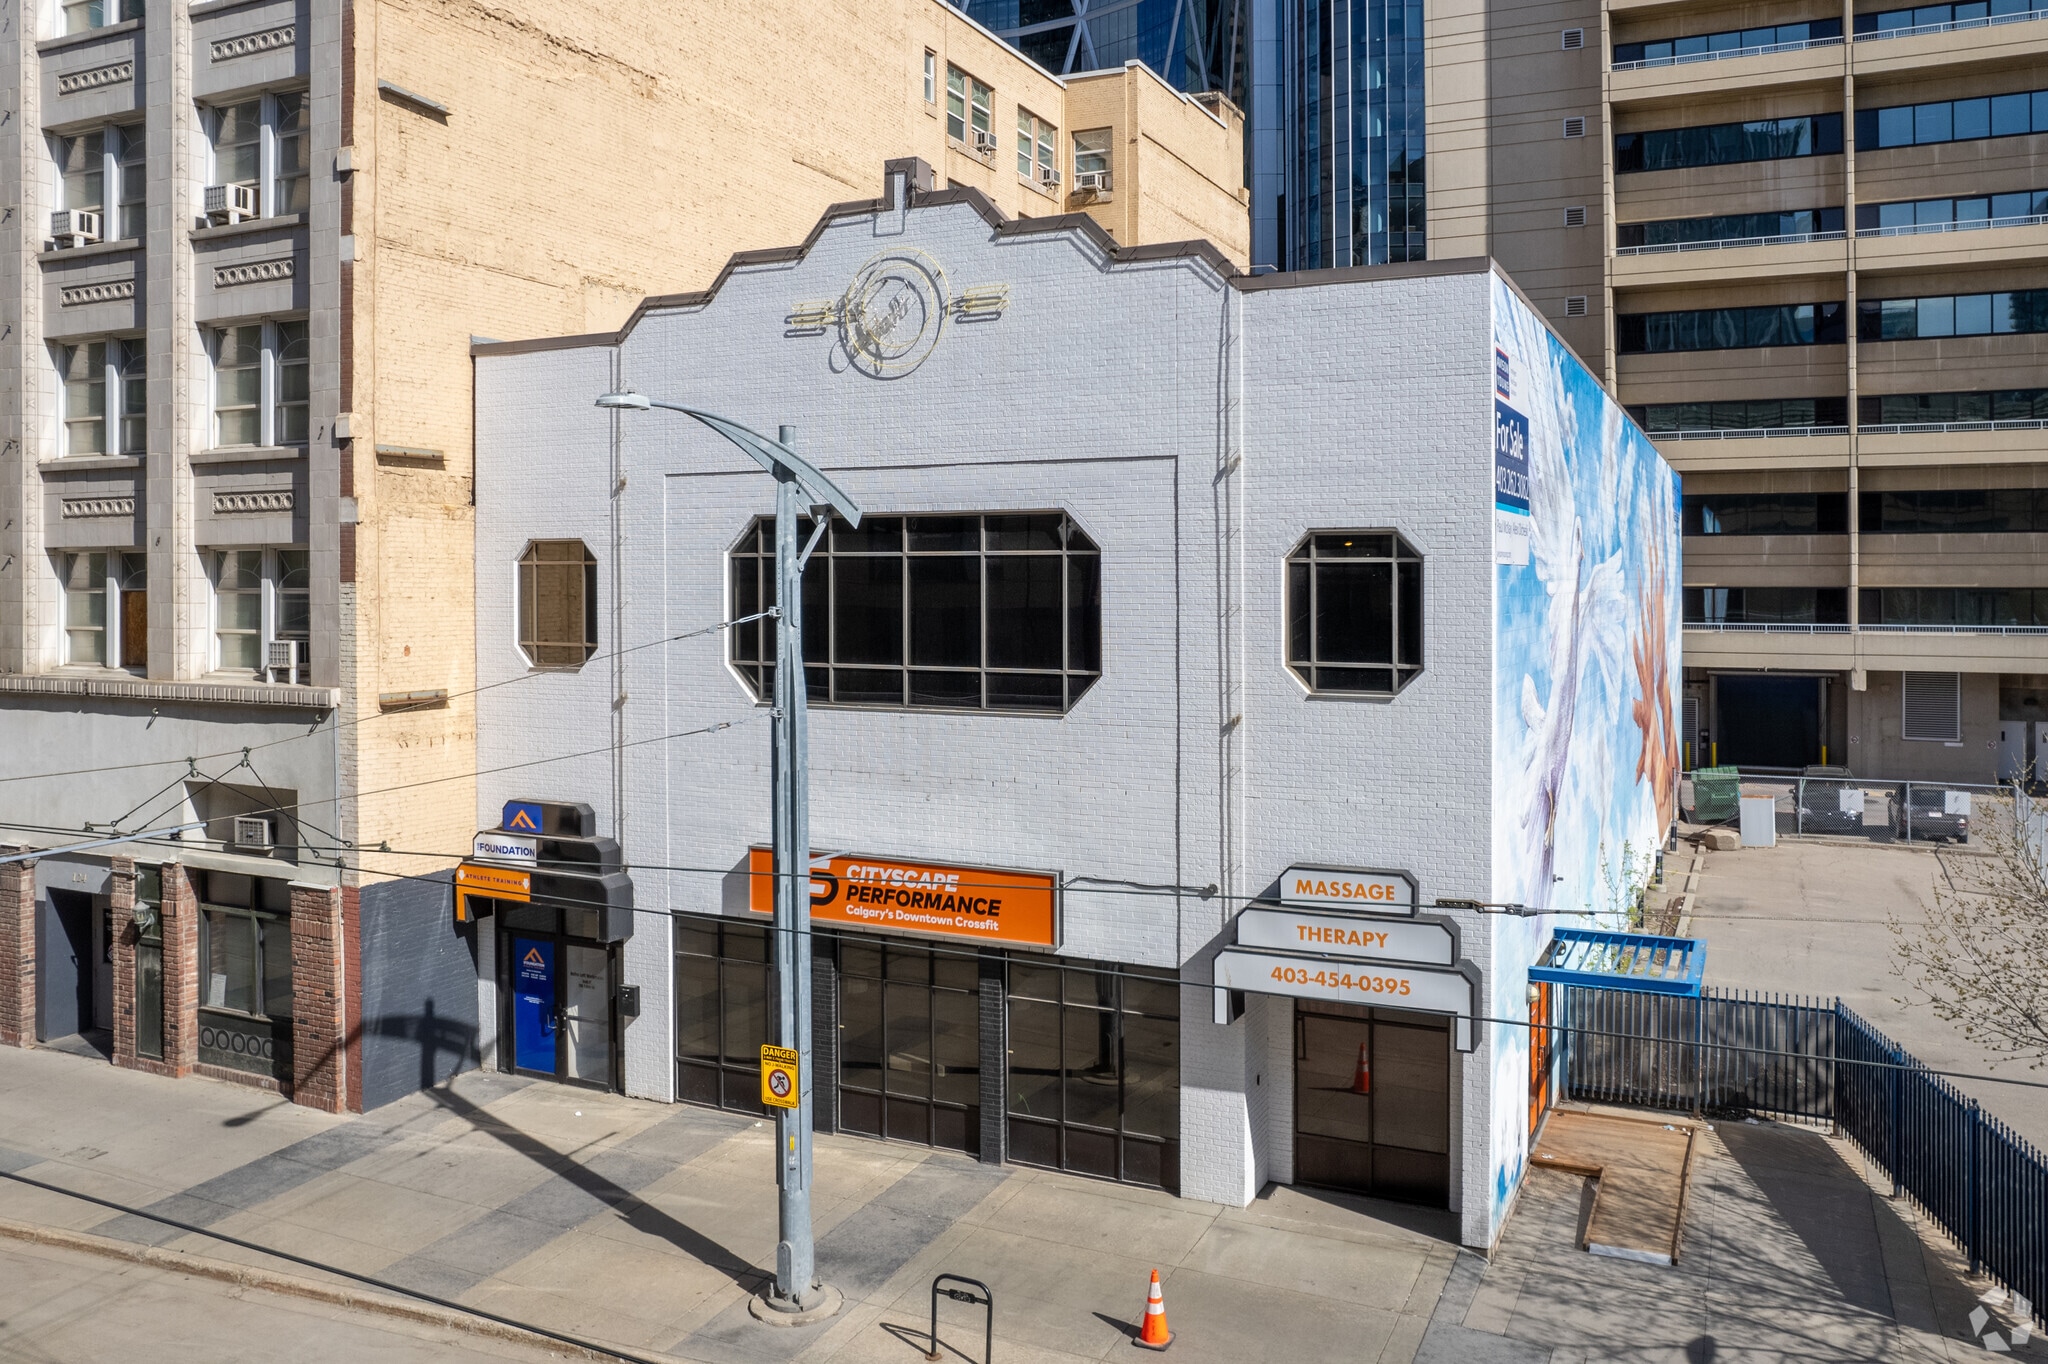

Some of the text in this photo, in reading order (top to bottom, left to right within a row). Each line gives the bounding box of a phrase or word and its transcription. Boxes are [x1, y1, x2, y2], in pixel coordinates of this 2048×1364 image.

[1496, 411, 1524, 461] For Sale
[480, 843, 535, 857] FOUNDATION
[466, 873, 523, 886] ATHLETE TRAINING
[846, 865, 959, 892] CITYSCAPE
[1295, 879, 1395, 901] MASSAGE
[846, 884, 1001, 917] PERFORMANCE
[846, 905, 999, 931] Calgary's Downtown Crossfit
[1296, 925, 1389, 948] THERAPY
[1270, 966, 1411, 996] 403-454-0395
[763, 1047, 796, 1060] DANGER
